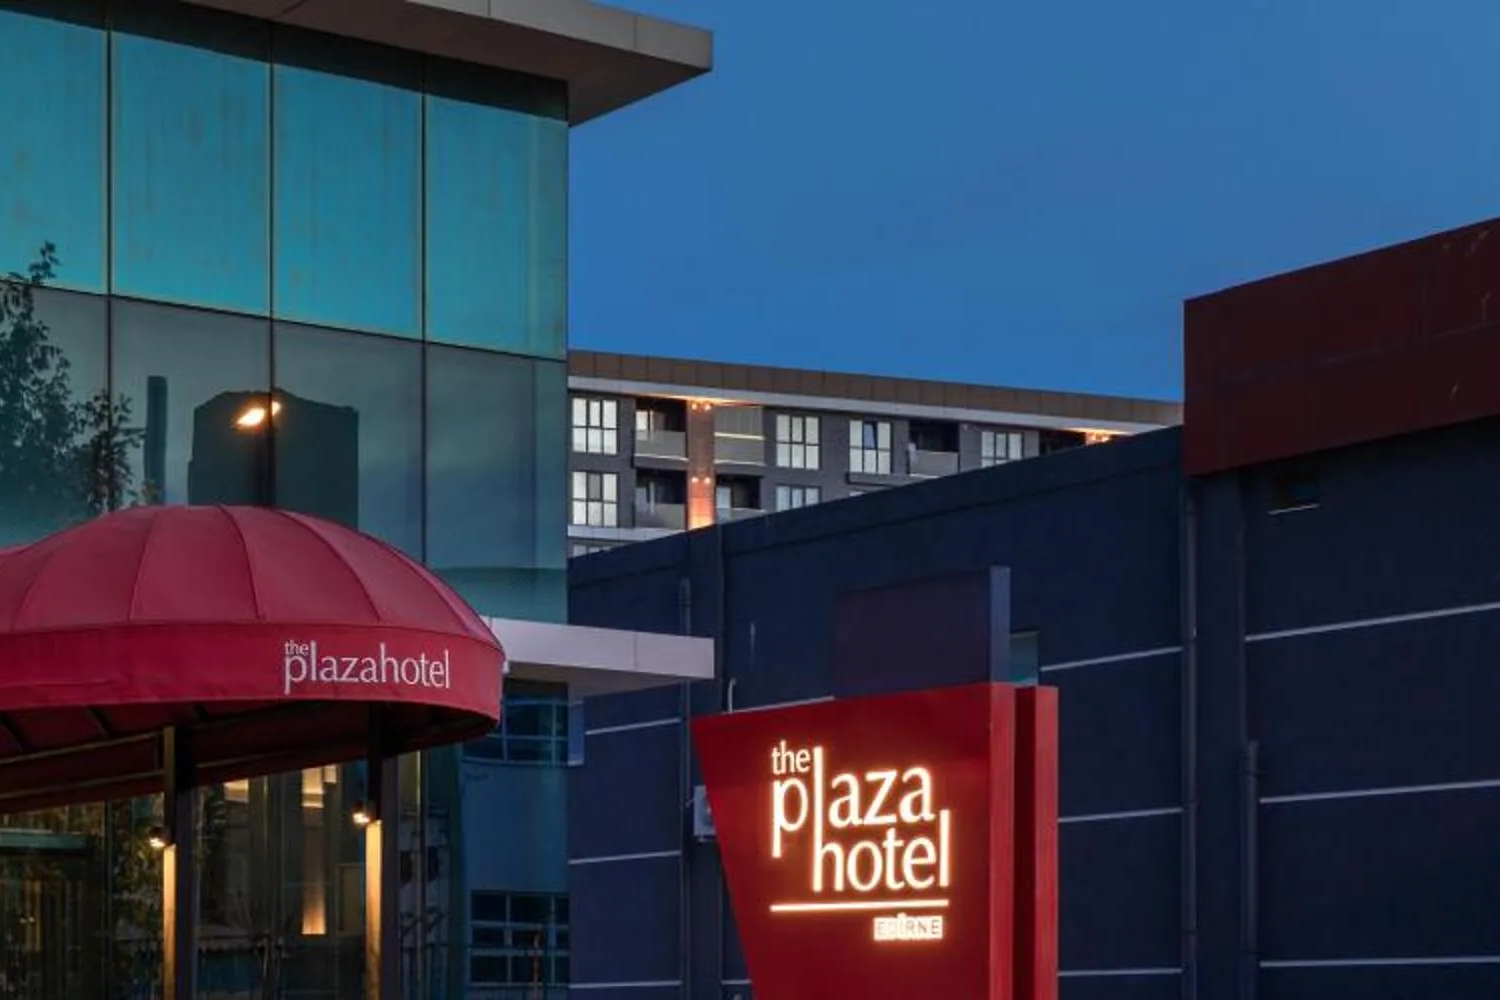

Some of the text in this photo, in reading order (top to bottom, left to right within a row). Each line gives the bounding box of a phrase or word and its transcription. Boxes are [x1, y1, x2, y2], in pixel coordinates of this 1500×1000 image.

[284, 640, 308, 656] the
[284, 641, 449, 695] plazahotel
[771, 739, 811, 776] the
[771, 745, 936, 859] plaza
[812, 809, 950, 893] hotel
